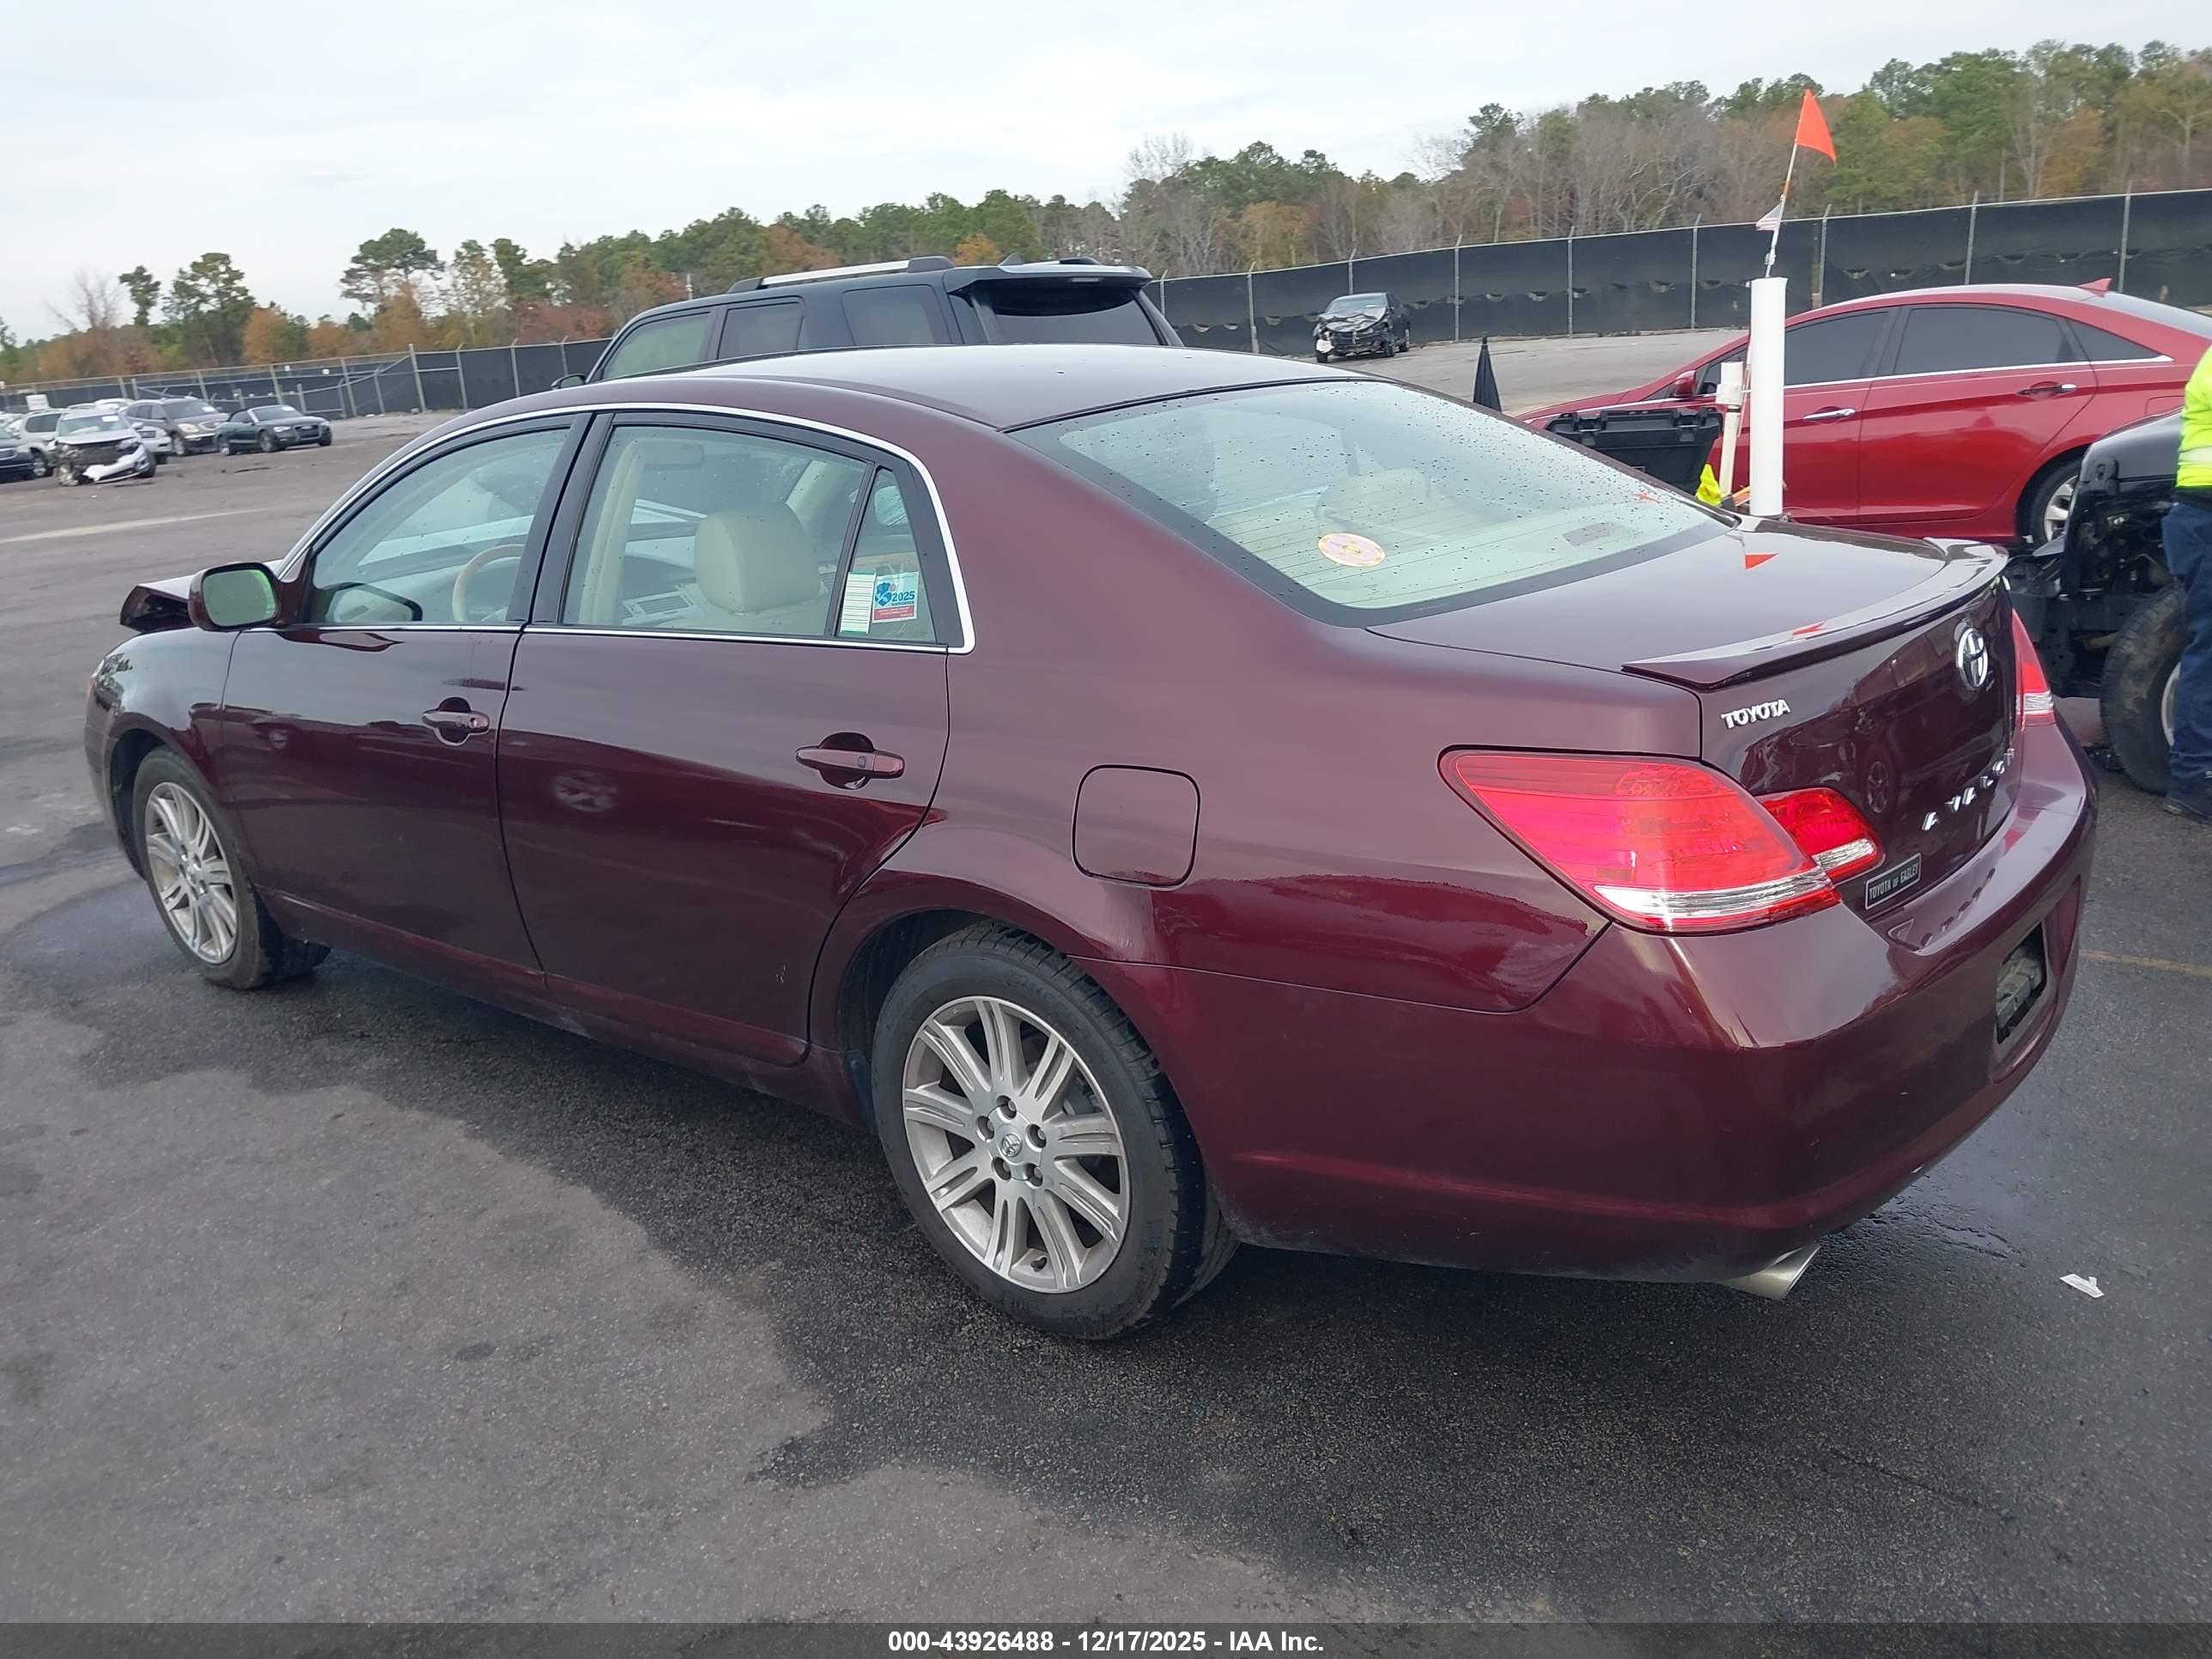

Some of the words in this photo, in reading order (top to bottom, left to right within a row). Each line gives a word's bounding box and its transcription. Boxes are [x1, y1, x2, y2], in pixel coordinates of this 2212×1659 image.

[892, 591, 915, 602] 2025
[1720, 699, 1791, 729] TOYOTA
[1869, 879, 1891, 899] TOYOTA
